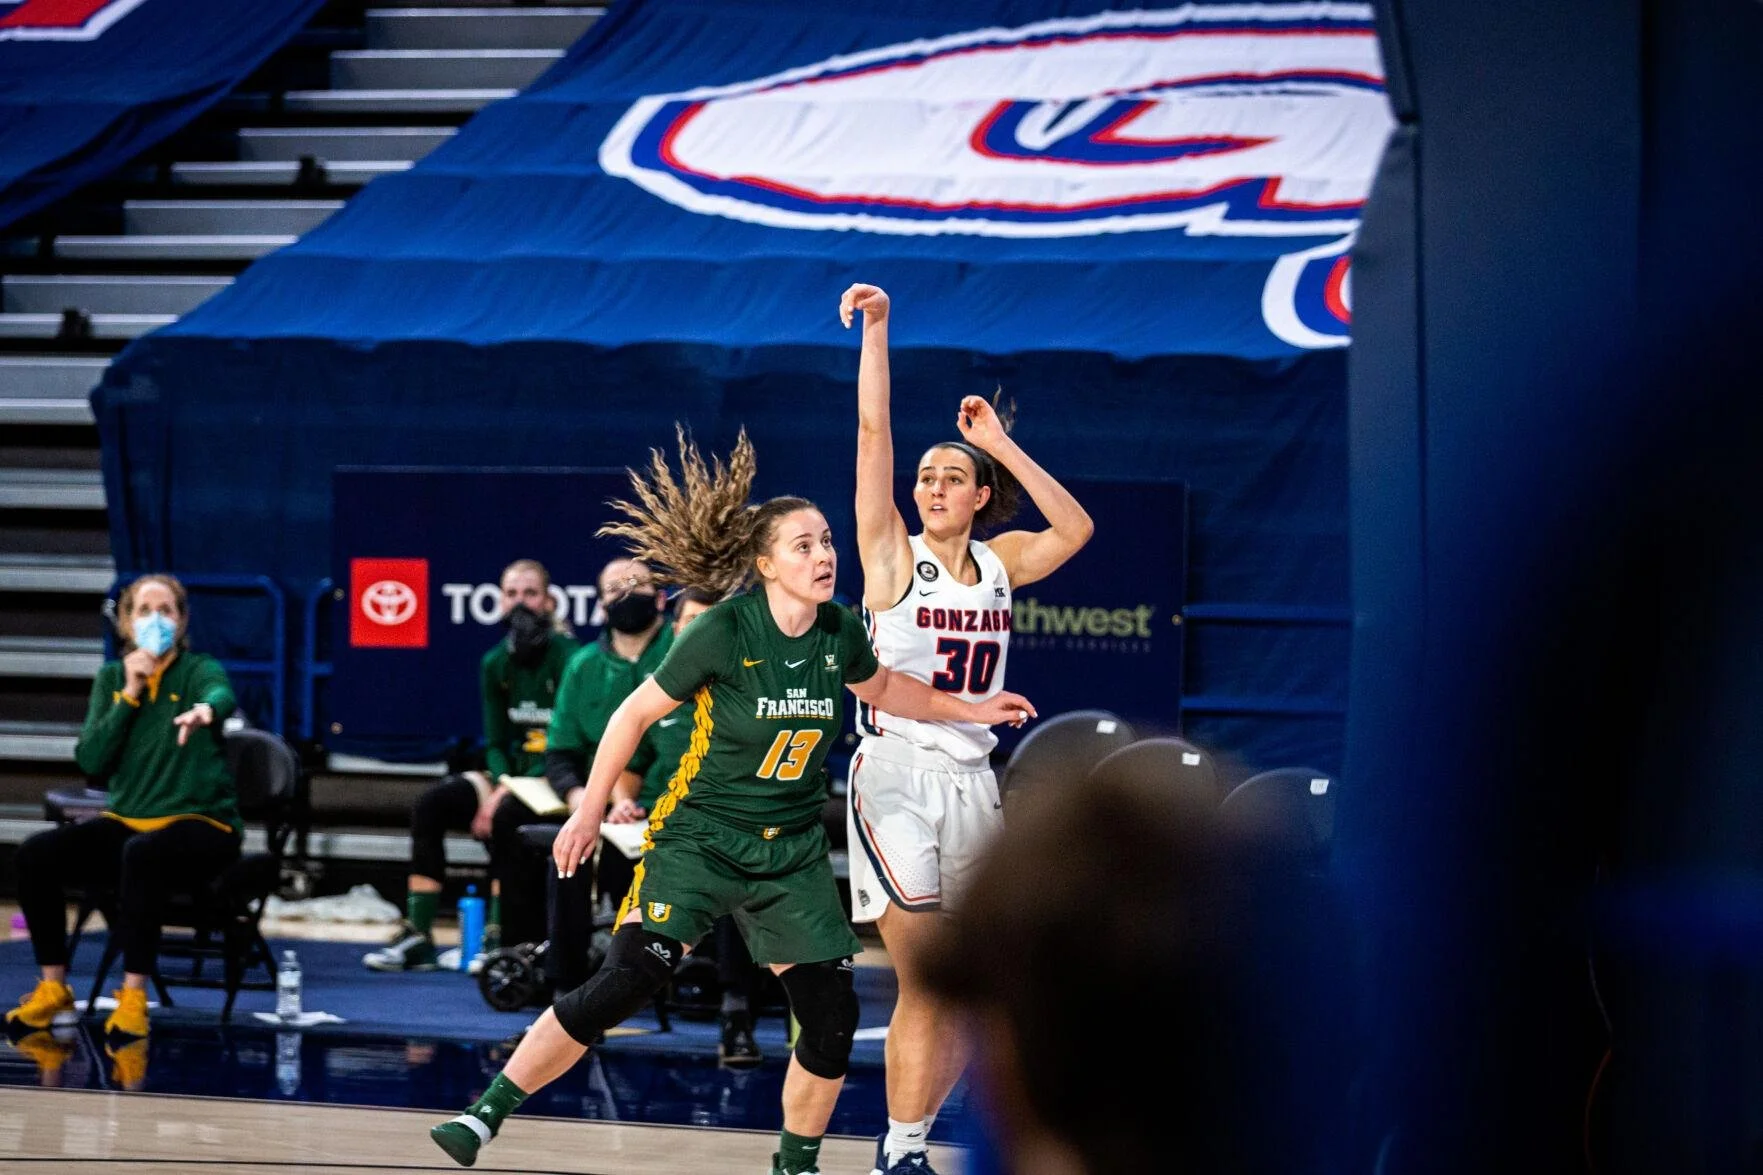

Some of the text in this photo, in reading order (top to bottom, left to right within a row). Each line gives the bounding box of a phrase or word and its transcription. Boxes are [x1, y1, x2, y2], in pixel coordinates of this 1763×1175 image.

[441, 582, 604, 627] TOOT
[1013, 597, 1153, 638] thwest
[931, 636, 1001, 695] 30
[756, 696, 834, 719] FRANCISCO
[786, 688, 807, 698] SAN
[756, 729, 823, 781] 13
